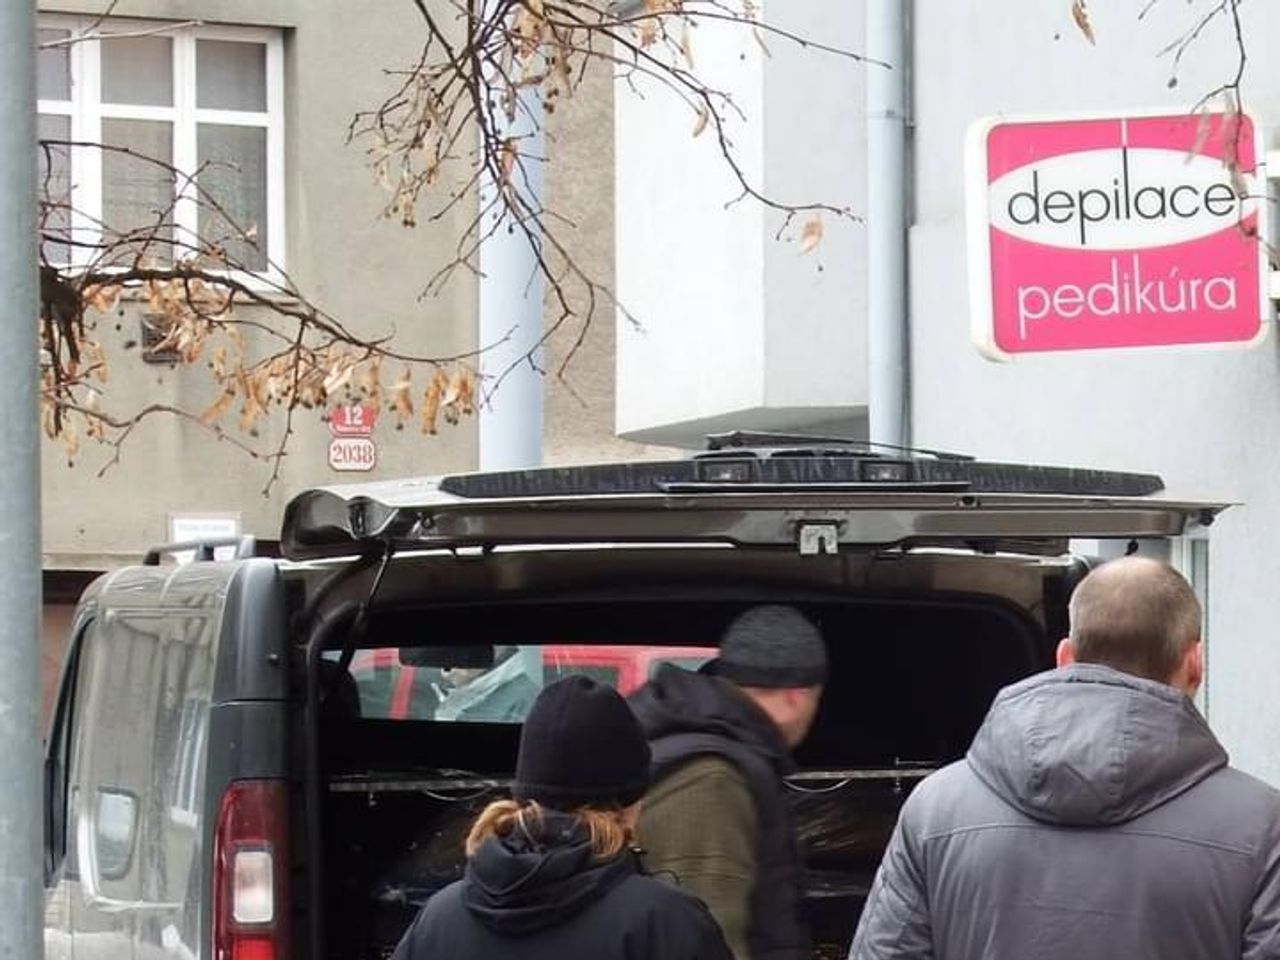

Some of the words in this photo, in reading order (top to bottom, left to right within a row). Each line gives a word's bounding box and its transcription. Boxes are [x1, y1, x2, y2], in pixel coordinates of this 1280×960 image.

[1007, 146, 1236, 245] depilace
[1018, 254, 1237, 340] pedikúra
[344, 405, 364, 425] 12
[332, 444, 373, 463] 2038
